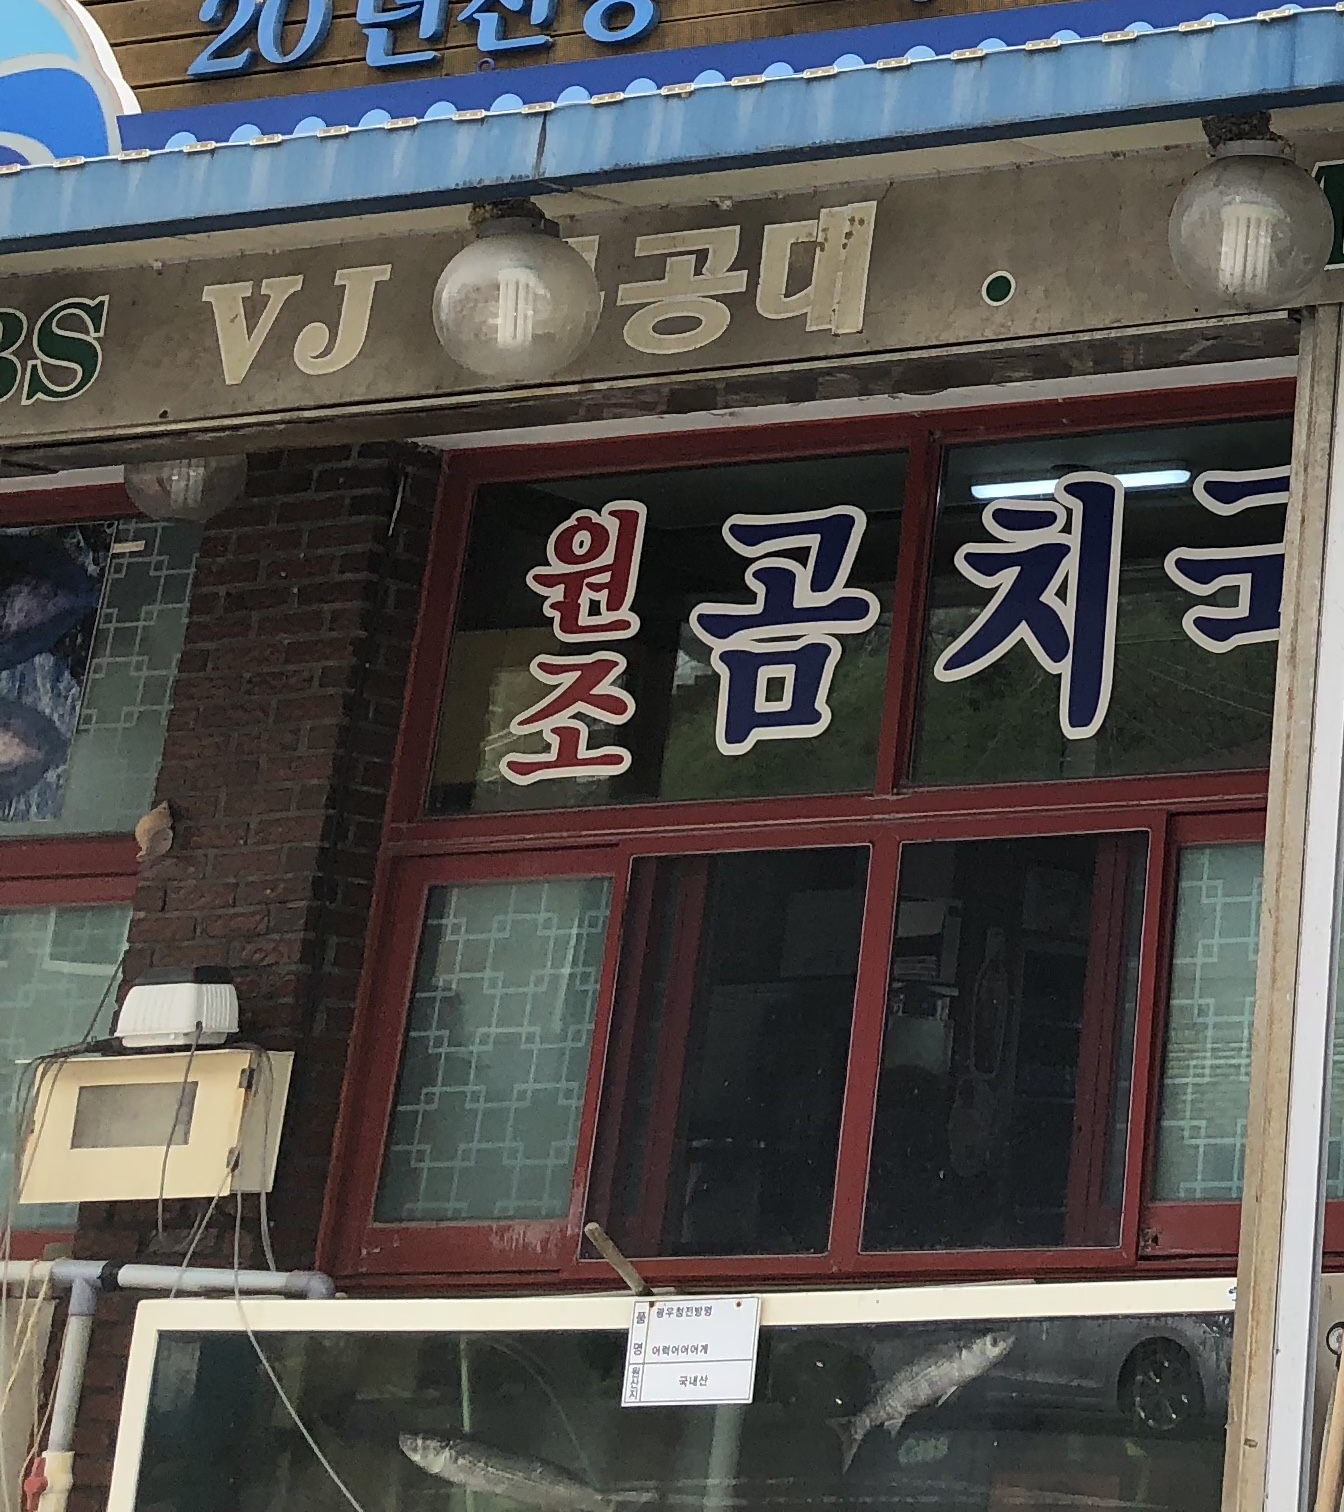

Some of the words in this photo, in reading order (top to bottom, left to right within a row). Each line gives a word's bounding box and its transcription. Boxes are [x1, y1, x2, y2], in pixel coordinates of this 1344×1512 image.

[201, 263, 393, 388] VJ
[562, 200, 878, 356] 공대
[500, 498, 648, 787] 원조
[678, 1374, 709, 1388] 국내산
